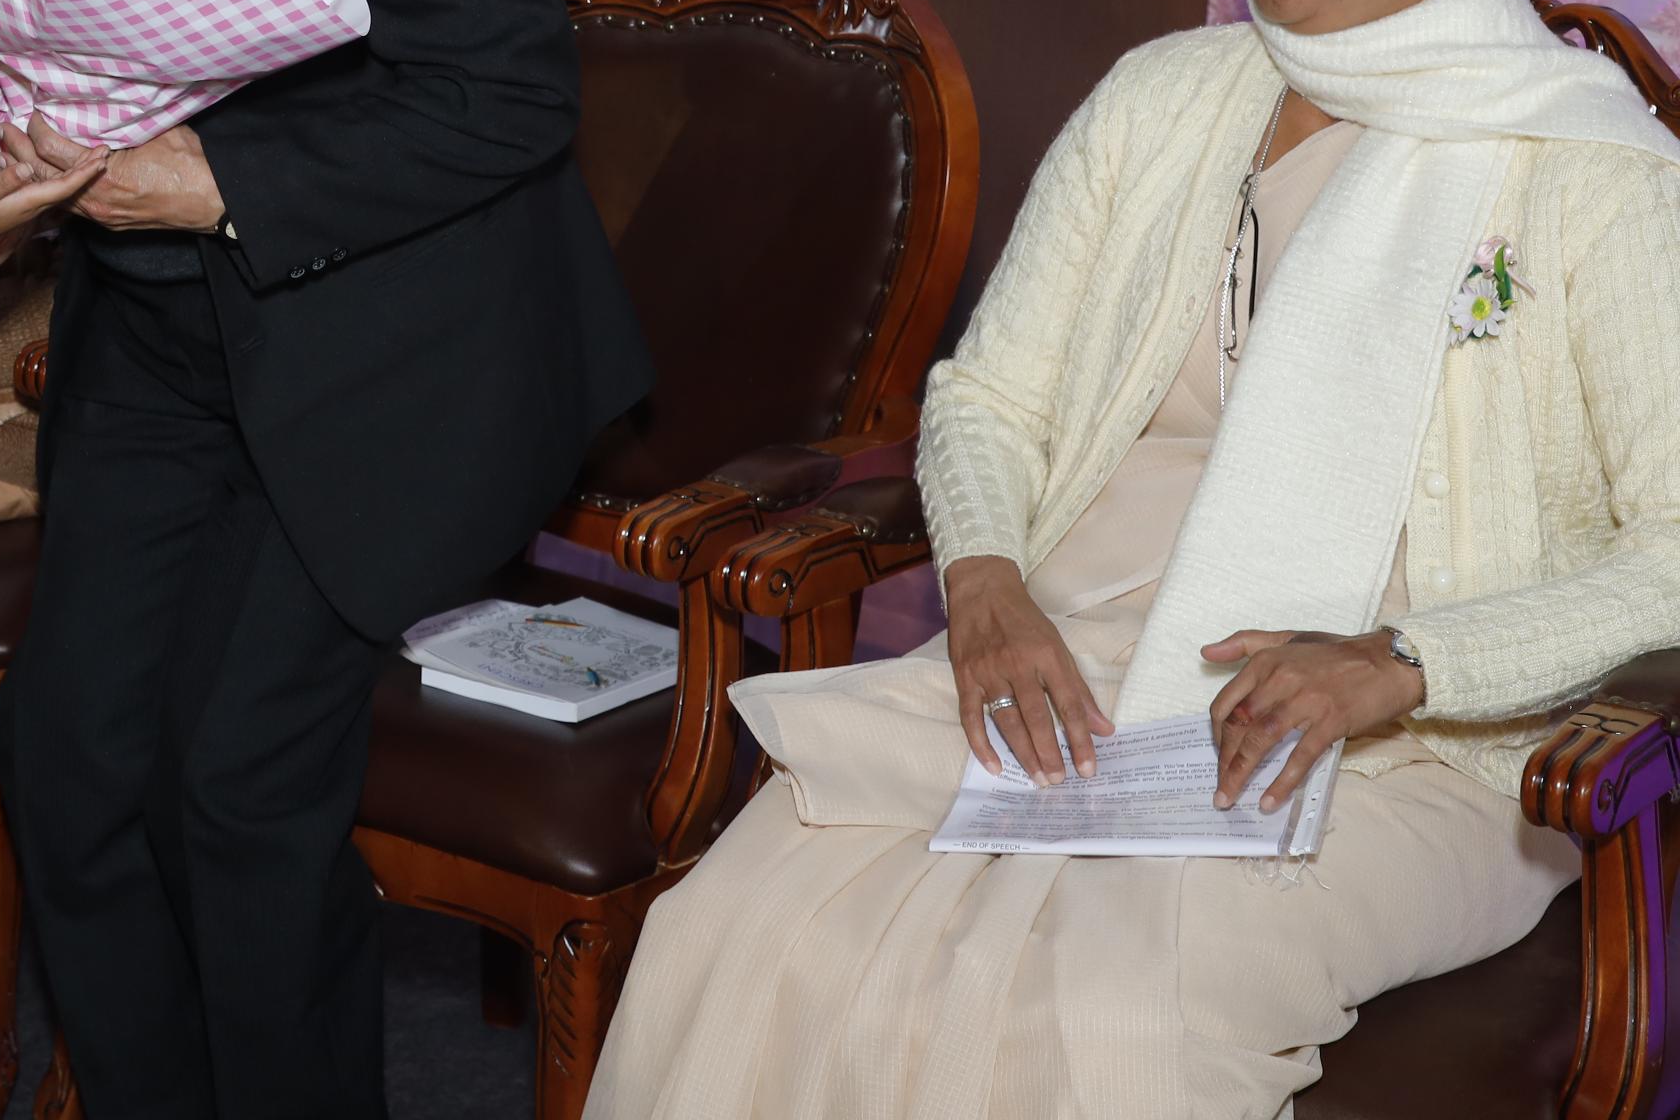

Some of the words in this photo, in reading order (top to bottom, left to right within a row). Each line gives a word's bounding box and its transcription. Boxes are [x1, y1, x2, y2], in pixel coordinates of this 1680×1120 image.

[1116, 737, 1150, 746] Student
[1151, 728, 1198, 741] Leadership
[991, 842, 1021, 850] SPEECH
